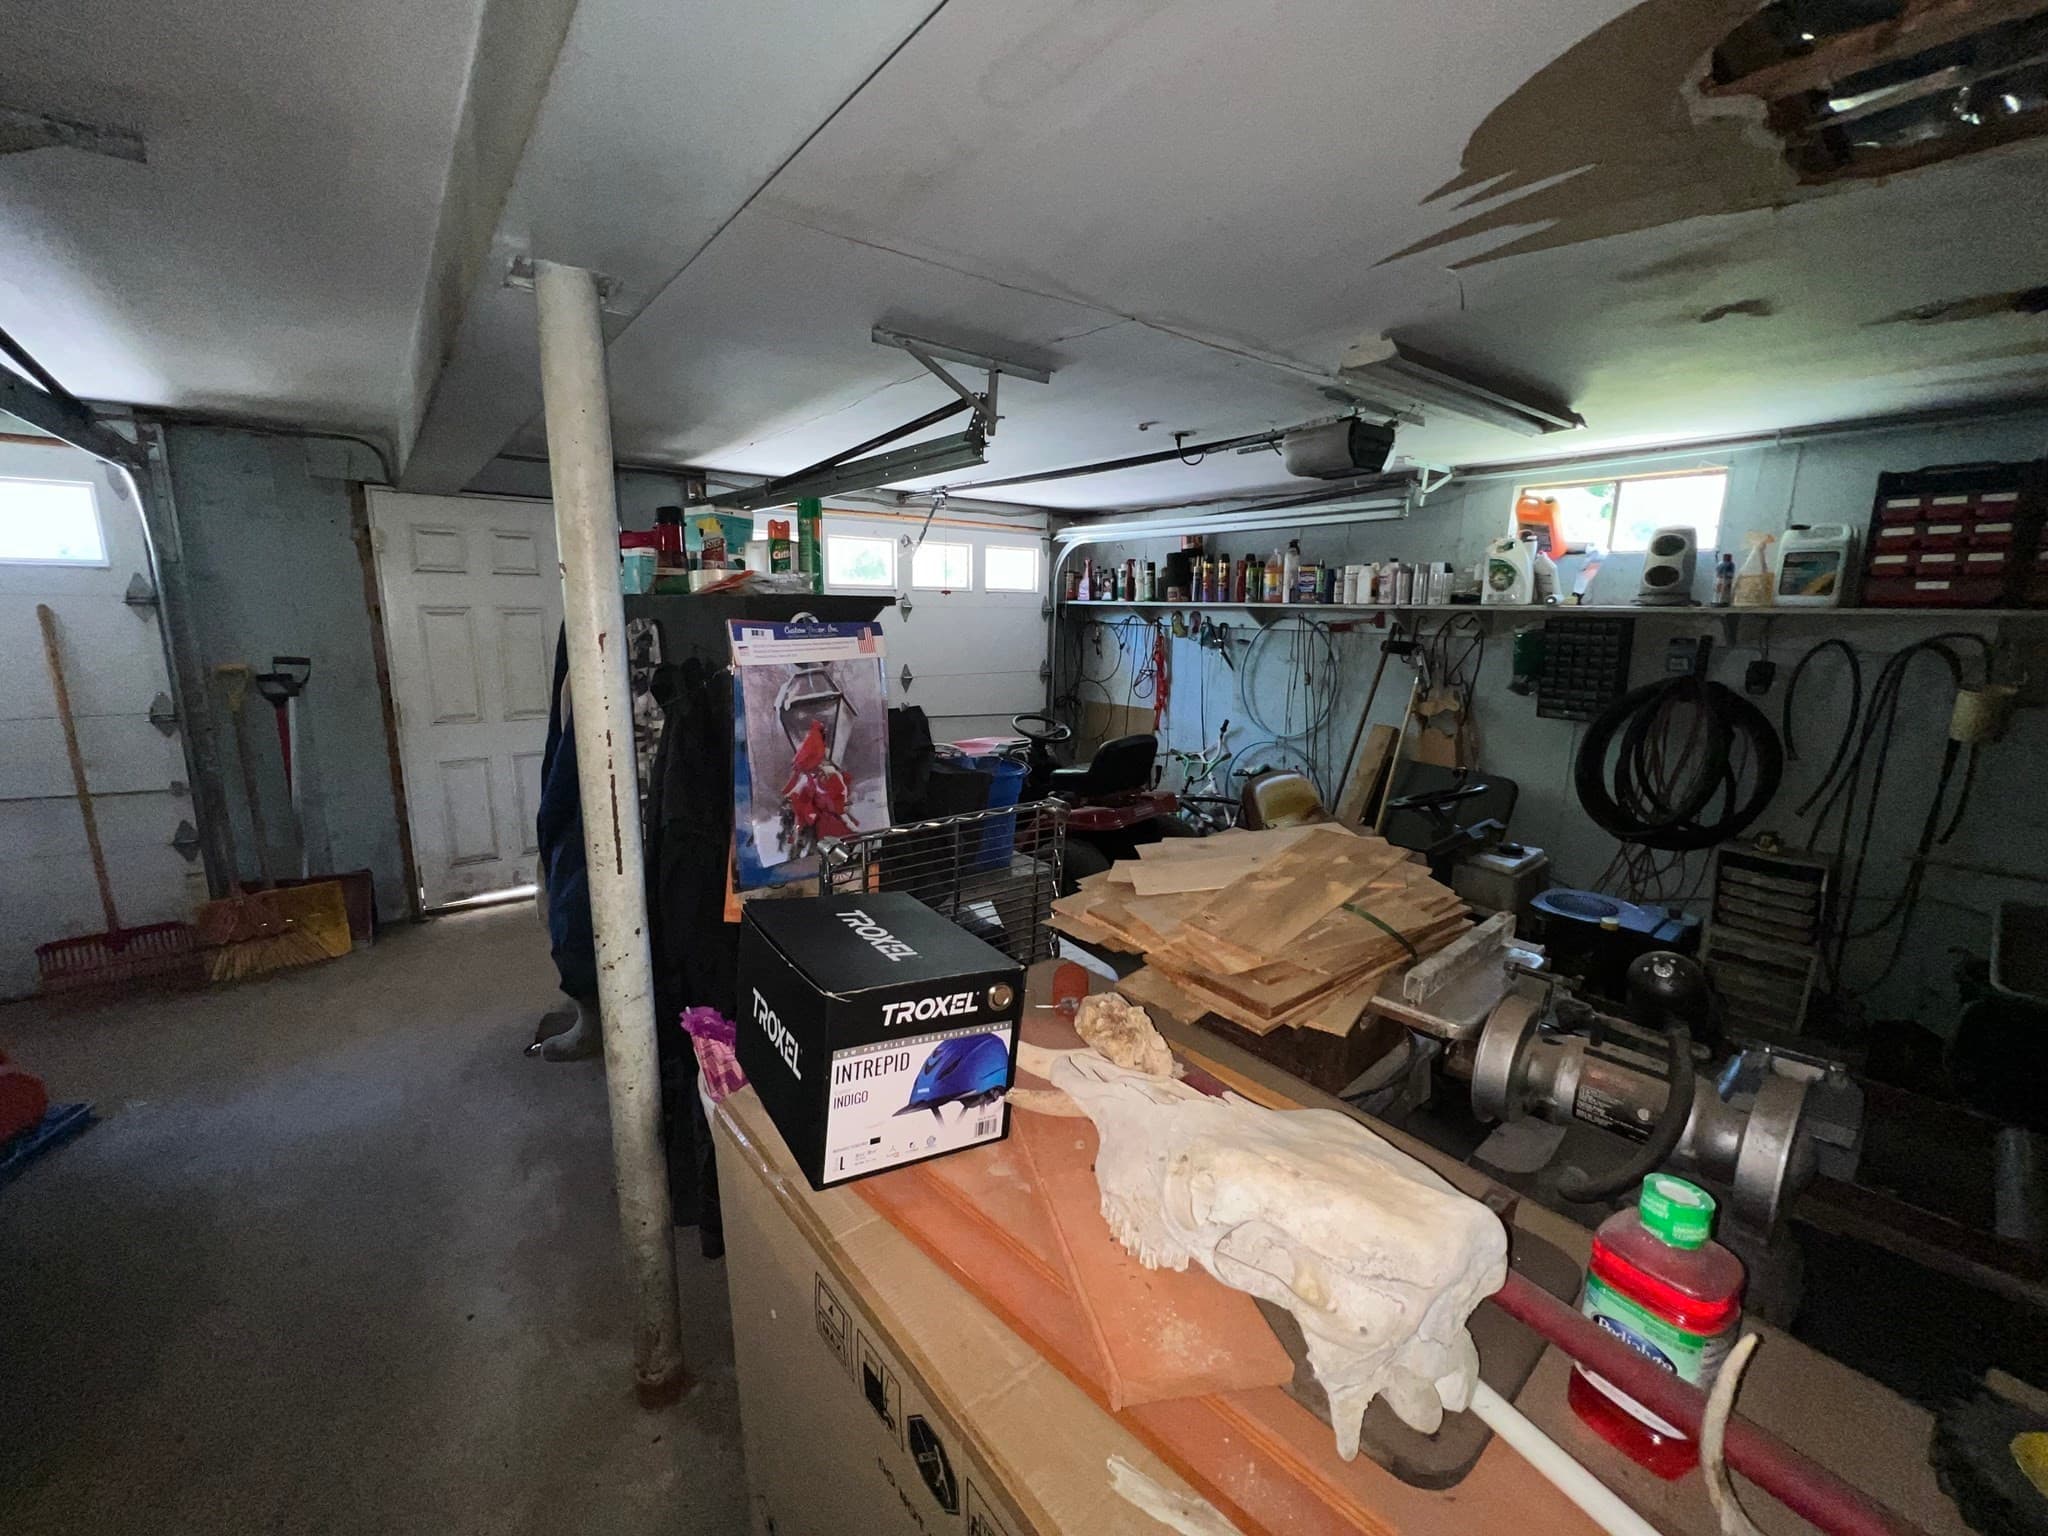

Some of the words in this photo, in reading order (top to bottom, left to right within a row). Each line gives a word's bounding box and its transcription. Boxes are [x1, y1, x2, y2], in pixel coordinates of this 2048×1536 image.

[836, 909, 920, 962] TROXEL
[882, 992, 979, 1026] TROXEL
[752, 987, 802, 1080] TROXEL
[863, 1039, 906, 1053] PROFILE
[835, 1051, 911, 1085] INTREPID
[832, 1091, 870, 1111] INDIGO
